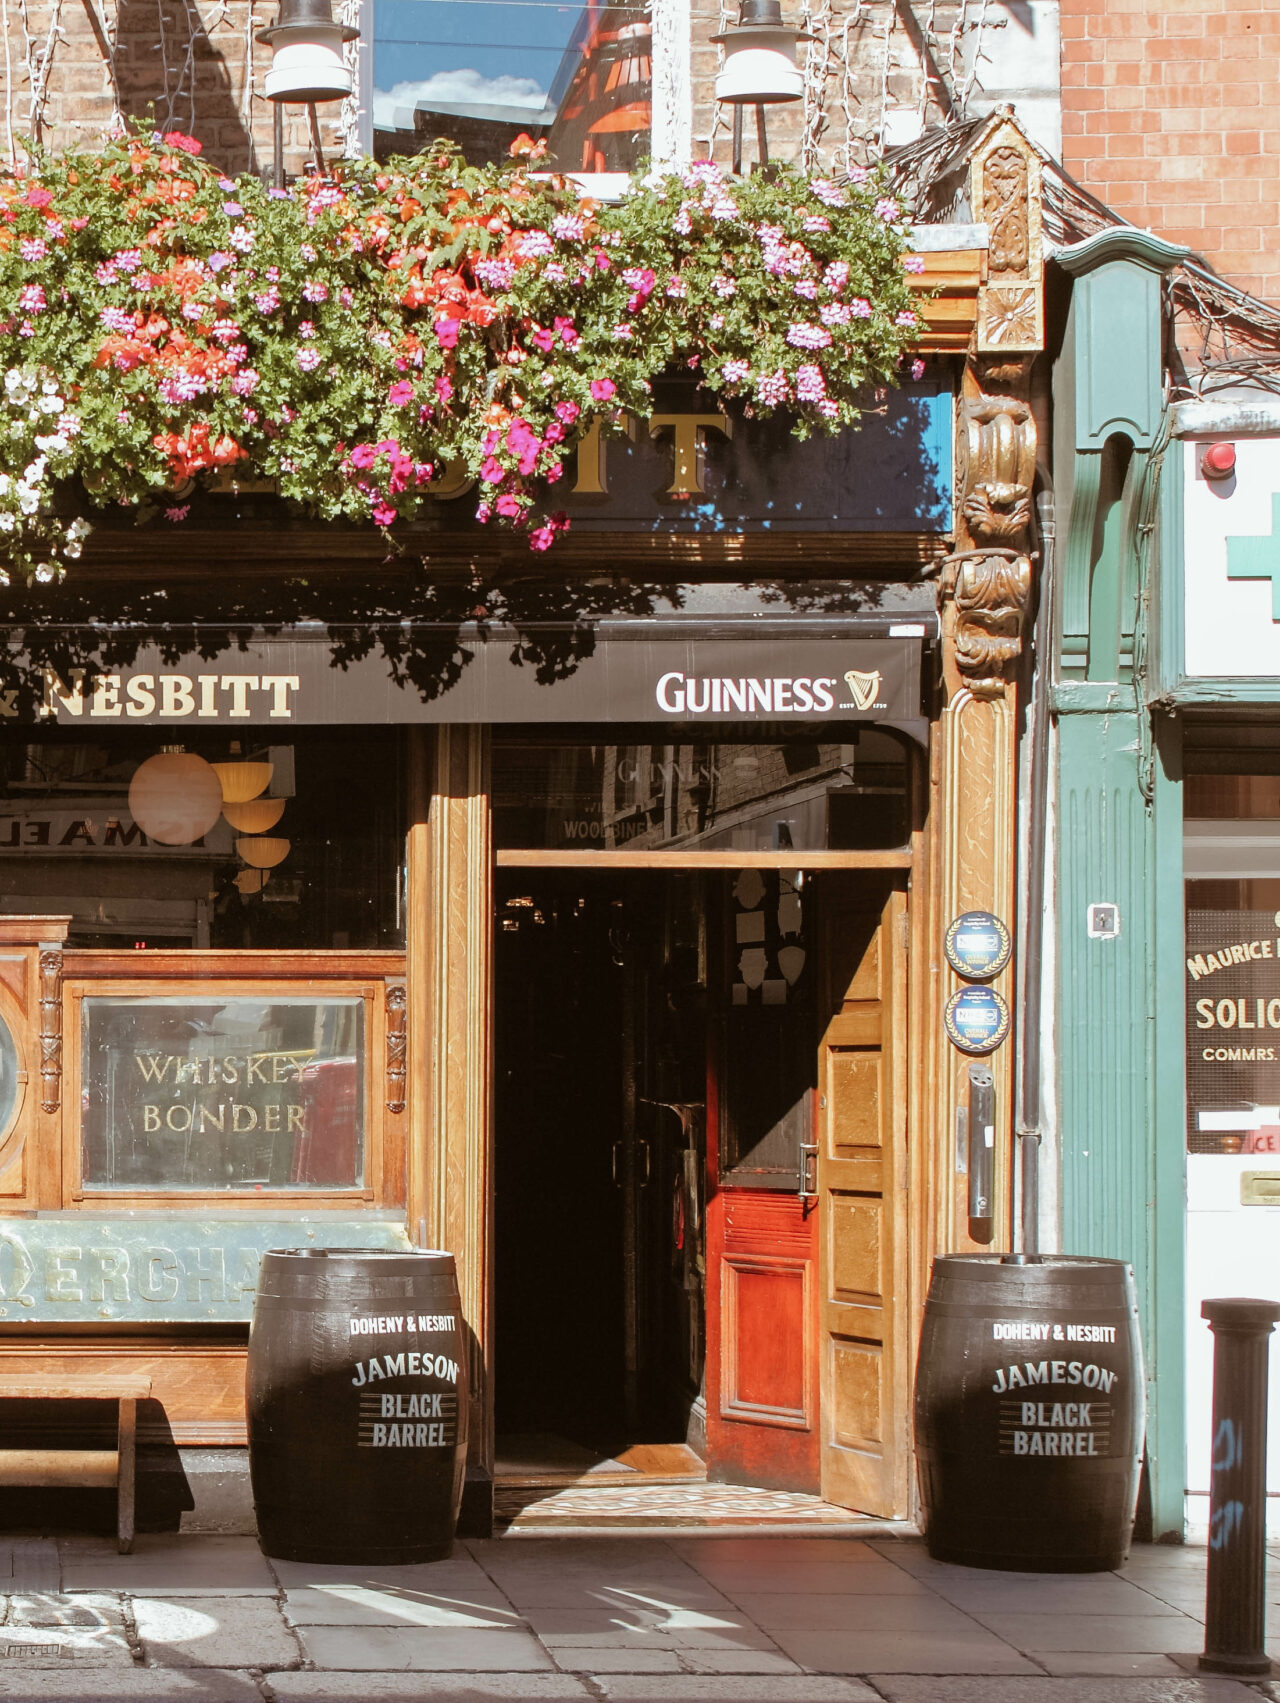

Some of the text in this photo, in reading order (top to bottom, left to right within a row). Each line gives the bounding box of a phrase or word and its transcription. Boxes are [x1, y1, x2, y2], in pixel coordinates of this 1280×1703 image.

[39, 667, 300, 718] NESBITT
[656, 672, 835, 713] GUINNESS
[1186, 940, 1273, 981] MAURICE
[1202, 1048, 1278, 1061] COMMRS.
[136, 1055, 313, 1084] WHISKEY
[144, 1104, 308, 1132] BONDER
[350, 1315, 456, 1335] DOHENY & NESBITT
[993, 1323, 1116, 1343] DOHENY & NESBITT
[351, 1352, 458, 1387] JAMESON
[992, 1360, 1115, 1394] JAMESON
[381, 1393, 443, 1418] BLACK
[1021, 1401, 1092, 1427] BLACK
[373, 1422, 447, 1447] BARREL
[1013, 1430, 1099, 1457] BARREL
